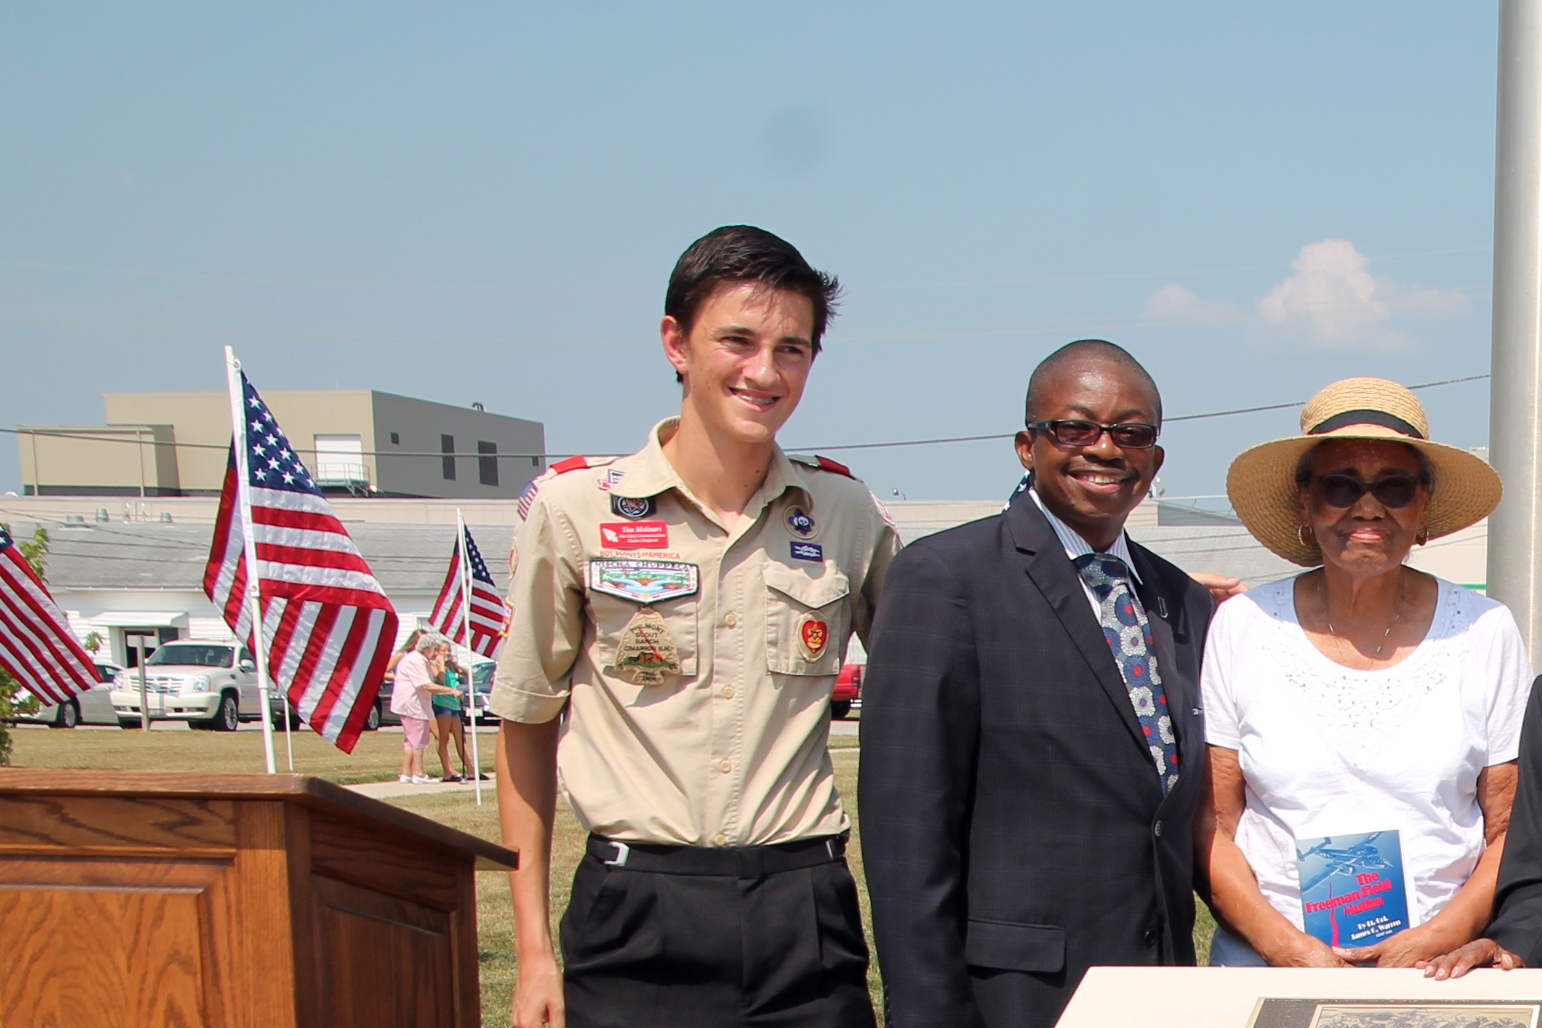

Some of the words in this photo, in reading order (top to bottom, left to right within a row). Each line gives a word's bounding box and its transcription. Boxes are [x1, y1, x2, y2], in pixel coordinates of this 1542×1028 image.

[648, 552, 681, 560] AMERICA
[1356, 872, 1379, 885] The
[1305, 891, 1361, 913] Freeman
[1361, 879, 1393, 897] Field
